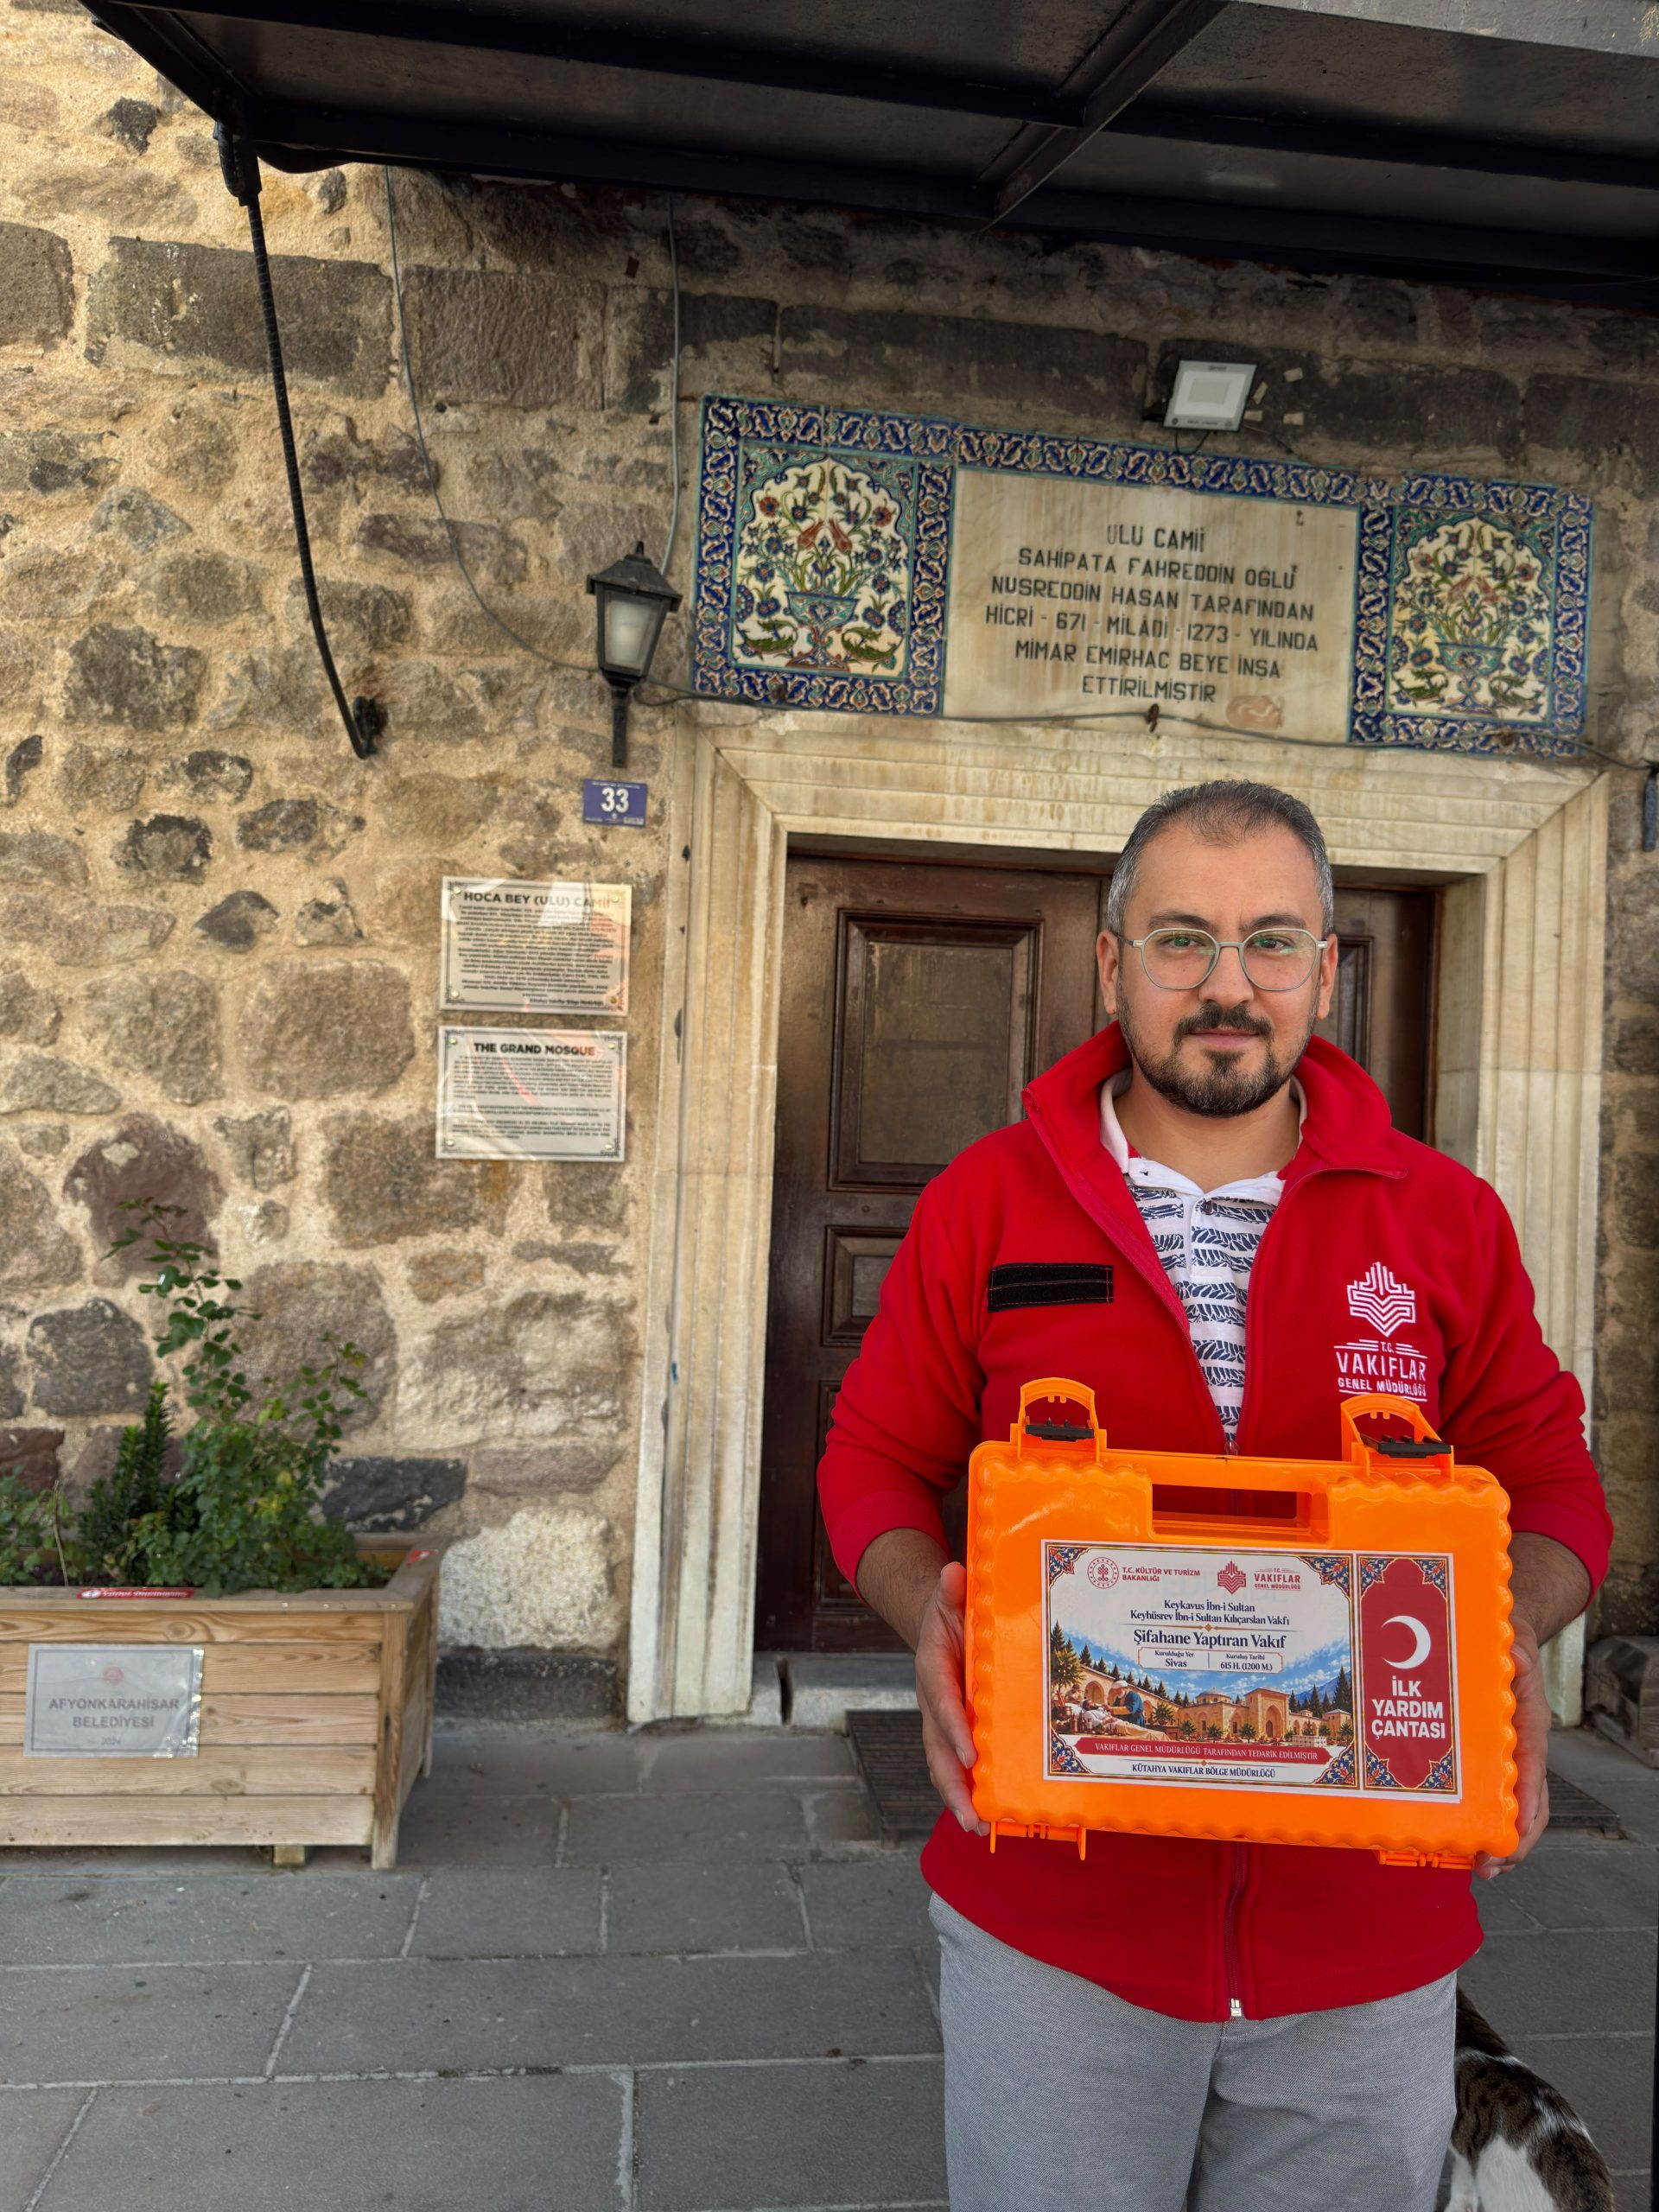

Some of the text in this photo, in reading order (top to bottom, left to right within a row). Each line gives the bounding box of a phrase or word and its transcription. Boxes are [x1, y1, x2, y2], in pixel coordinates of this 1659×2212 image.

[1107, 524, 1205, 552] ULU CAMİİ
[1019, 547, 1296, 590] SAHİPATA FAHREDDİN OĞLU
[992, 575, 1314, 622] NUSREDDİN HASAN TARAFINDAN
[986, 602, 1033, 628] HİCRİ
[1056, 612, 1086, 632] 671
[1187, 623, 1229, 644] 1273
[1250, 628, 1319, 652] YILINDA
[1015, 638, 1077, 663] MİMAR
[1086, 645, 1170, 670] EMİRHAC
[1179, 653, 1229, 675] BEYE
[1083, 674, 1217, 703] ETTİRİLMİŞTİR
[601, 786, 630, 813] 33
[464, 892, 501, 902] HOCA
[505, 893, 531, 905] BEY
[534, 895, 570, 908] (ULU)
[474, 1042, 595, 1057] THE GRAND MOSQUE
[1380, 1341, 1395, 1353] T.C.
[1336, 1351, 1427, 1382] VAKIFLAR
[1338, 1377, 1373, 1390] GENEL
[1122, 1574, 1160, 1583] BAKANLIĞI
[1135, 1567, 1162, 1575] KÜLTÜR
[1173, 1568, 1201, 1577] TURİZM
[1254, 1573, 1301, 1584] VAKIFLAR
[1164, 1599, 1255, 1612] Keykavus İbn-i Sultan
[1130, 1609, 1290, 1625] Keyhüsrev İbn-i Sultan Kılıçarslan Vakfı
[1134, 1629, 1287, 1649] Şifahane Yaptıran Vakıf
[1154, 1649, 1185, 1658] Kurulduğu
[1165, 1657, 1188, 1668] Sivas
[1220, 1661, 1274, 1671] 615 H. (1200 M.)
[1391, 1675, 1422, 1698] İLK
[48, 1698, 180, 1711] AFYONKARAHİSAR
[1371, 1699, 1444, 1719] YARDIM
[73, 1714, 155, 1728] BELEDİYESİ
[1370, 1719, 1446, 1740] ÇANTASI
[1095, 1742, 1319, 1761] VAKIFLAR GENEL MÜDÜRLÜĞÜ TARAFINDAN TEDARİK EDİLMİŞTİR
[1132, 1763, 1275, 1778] KÜTAHYA VAKIFLAR BÖLGE MÜDÜRLÜĞÜ
